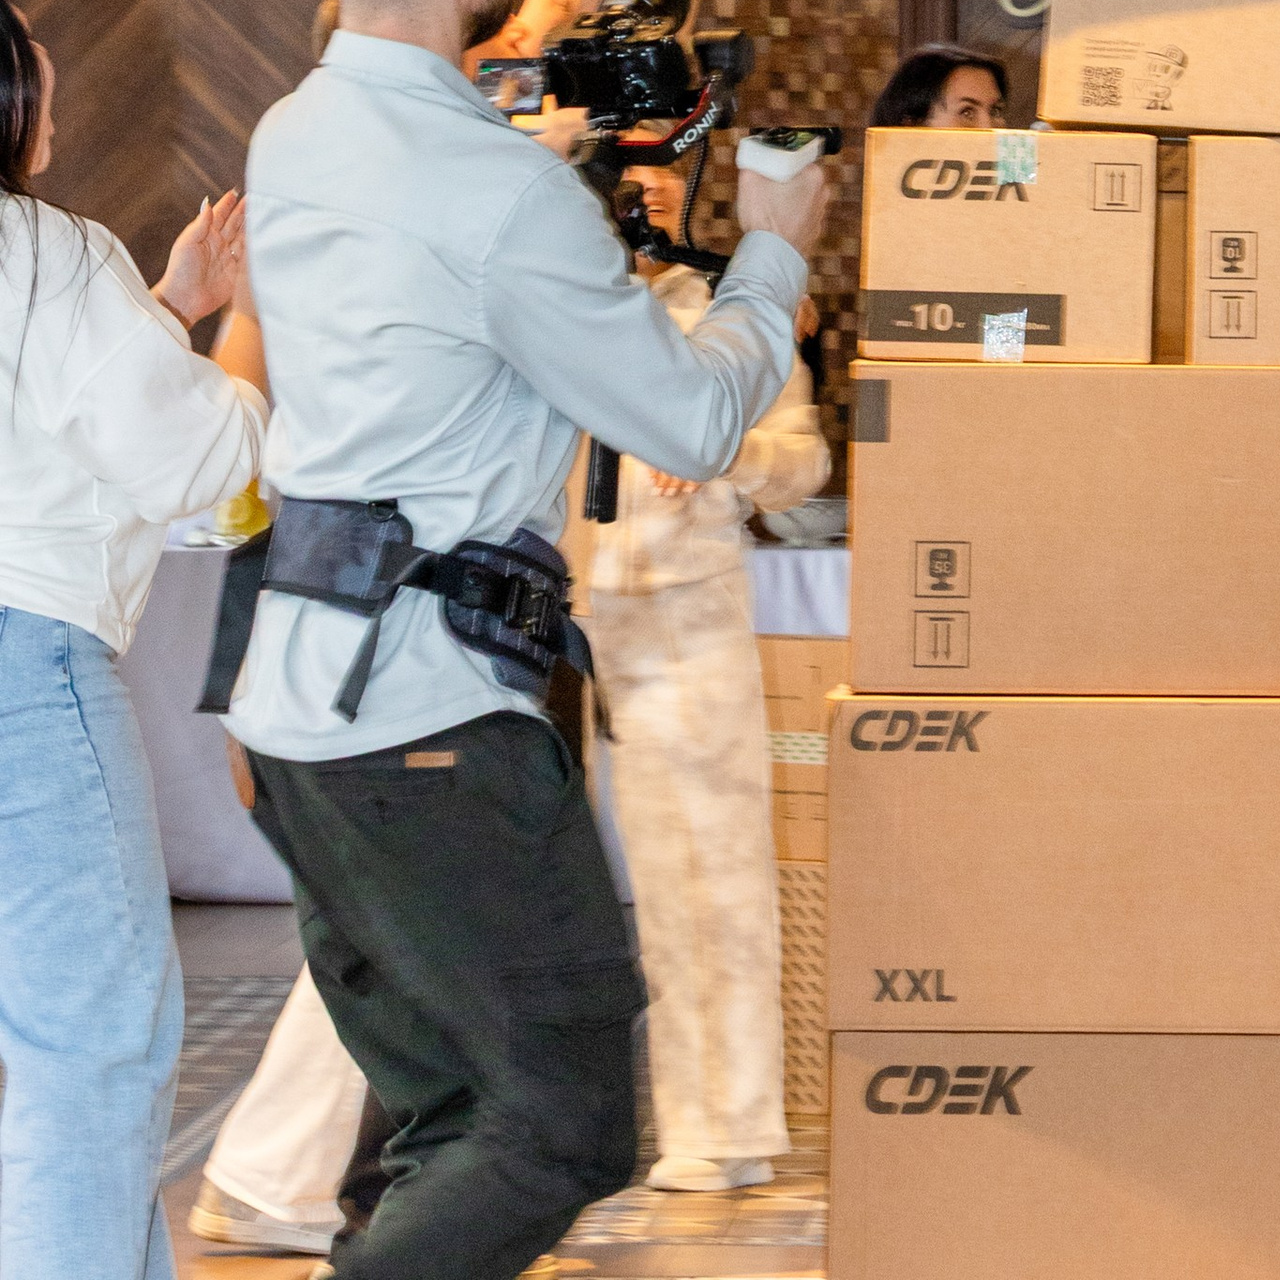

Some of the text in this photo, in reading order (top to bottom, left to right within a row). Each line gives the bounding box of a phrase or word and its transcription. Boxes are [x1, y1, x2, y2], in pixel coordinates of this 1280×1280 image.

[672, 101, 718, 154] RONIN
[910, 303, 954, 331] 10
[848, 710, 990, 752] CDEK
[874, 969, 956, 1002] XXL
[865, 1065, 1033, 1115] CDEK
